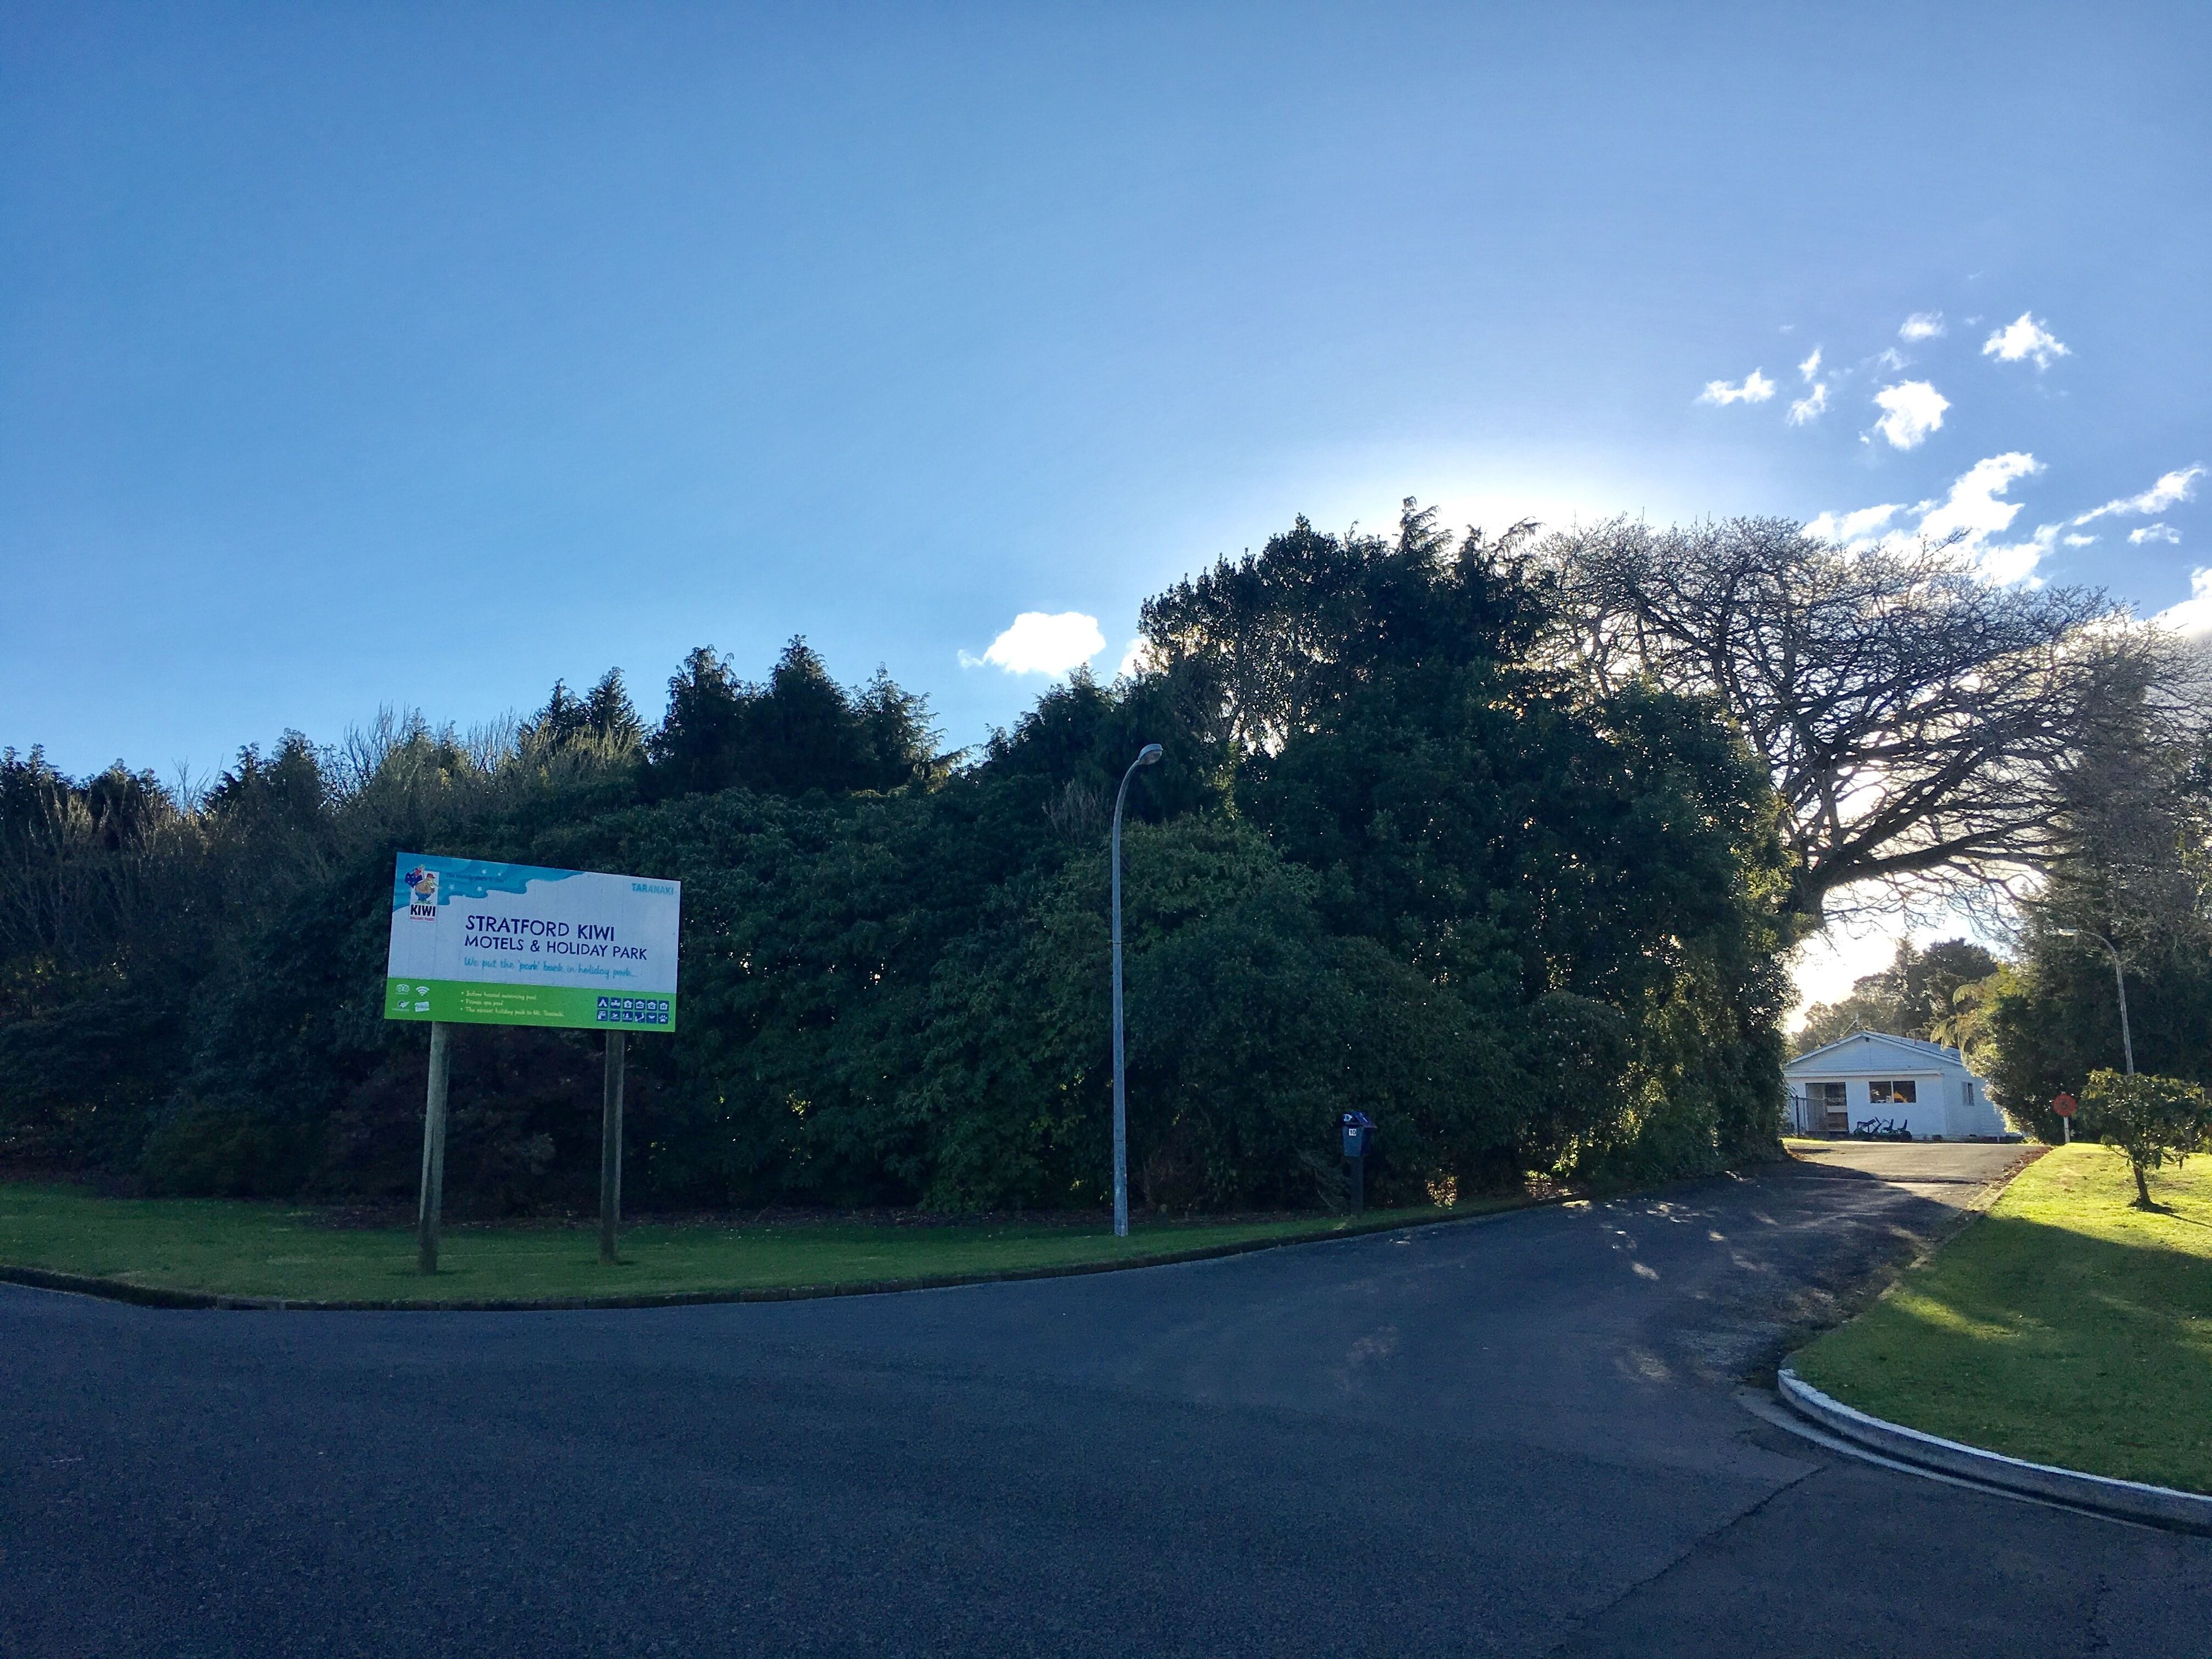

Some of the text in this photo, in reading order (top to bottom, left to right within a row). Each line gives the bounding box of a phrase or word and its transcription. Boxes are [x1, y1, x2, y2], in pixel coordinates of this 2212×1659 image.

[631, 882, 674, 895] TARANAKI
[410, 904, 436, 917] KIWI
[465, 915, 615, 941] STRATFORD KIWI
[464, 935, 647, 961] MOTELS & HOLIDAY PARK
[464, 957, 479, 967] We
[482, 959, 497, 969] put
[500, 959, 514, 968] the
[578, 963, 609, 979] holiday
